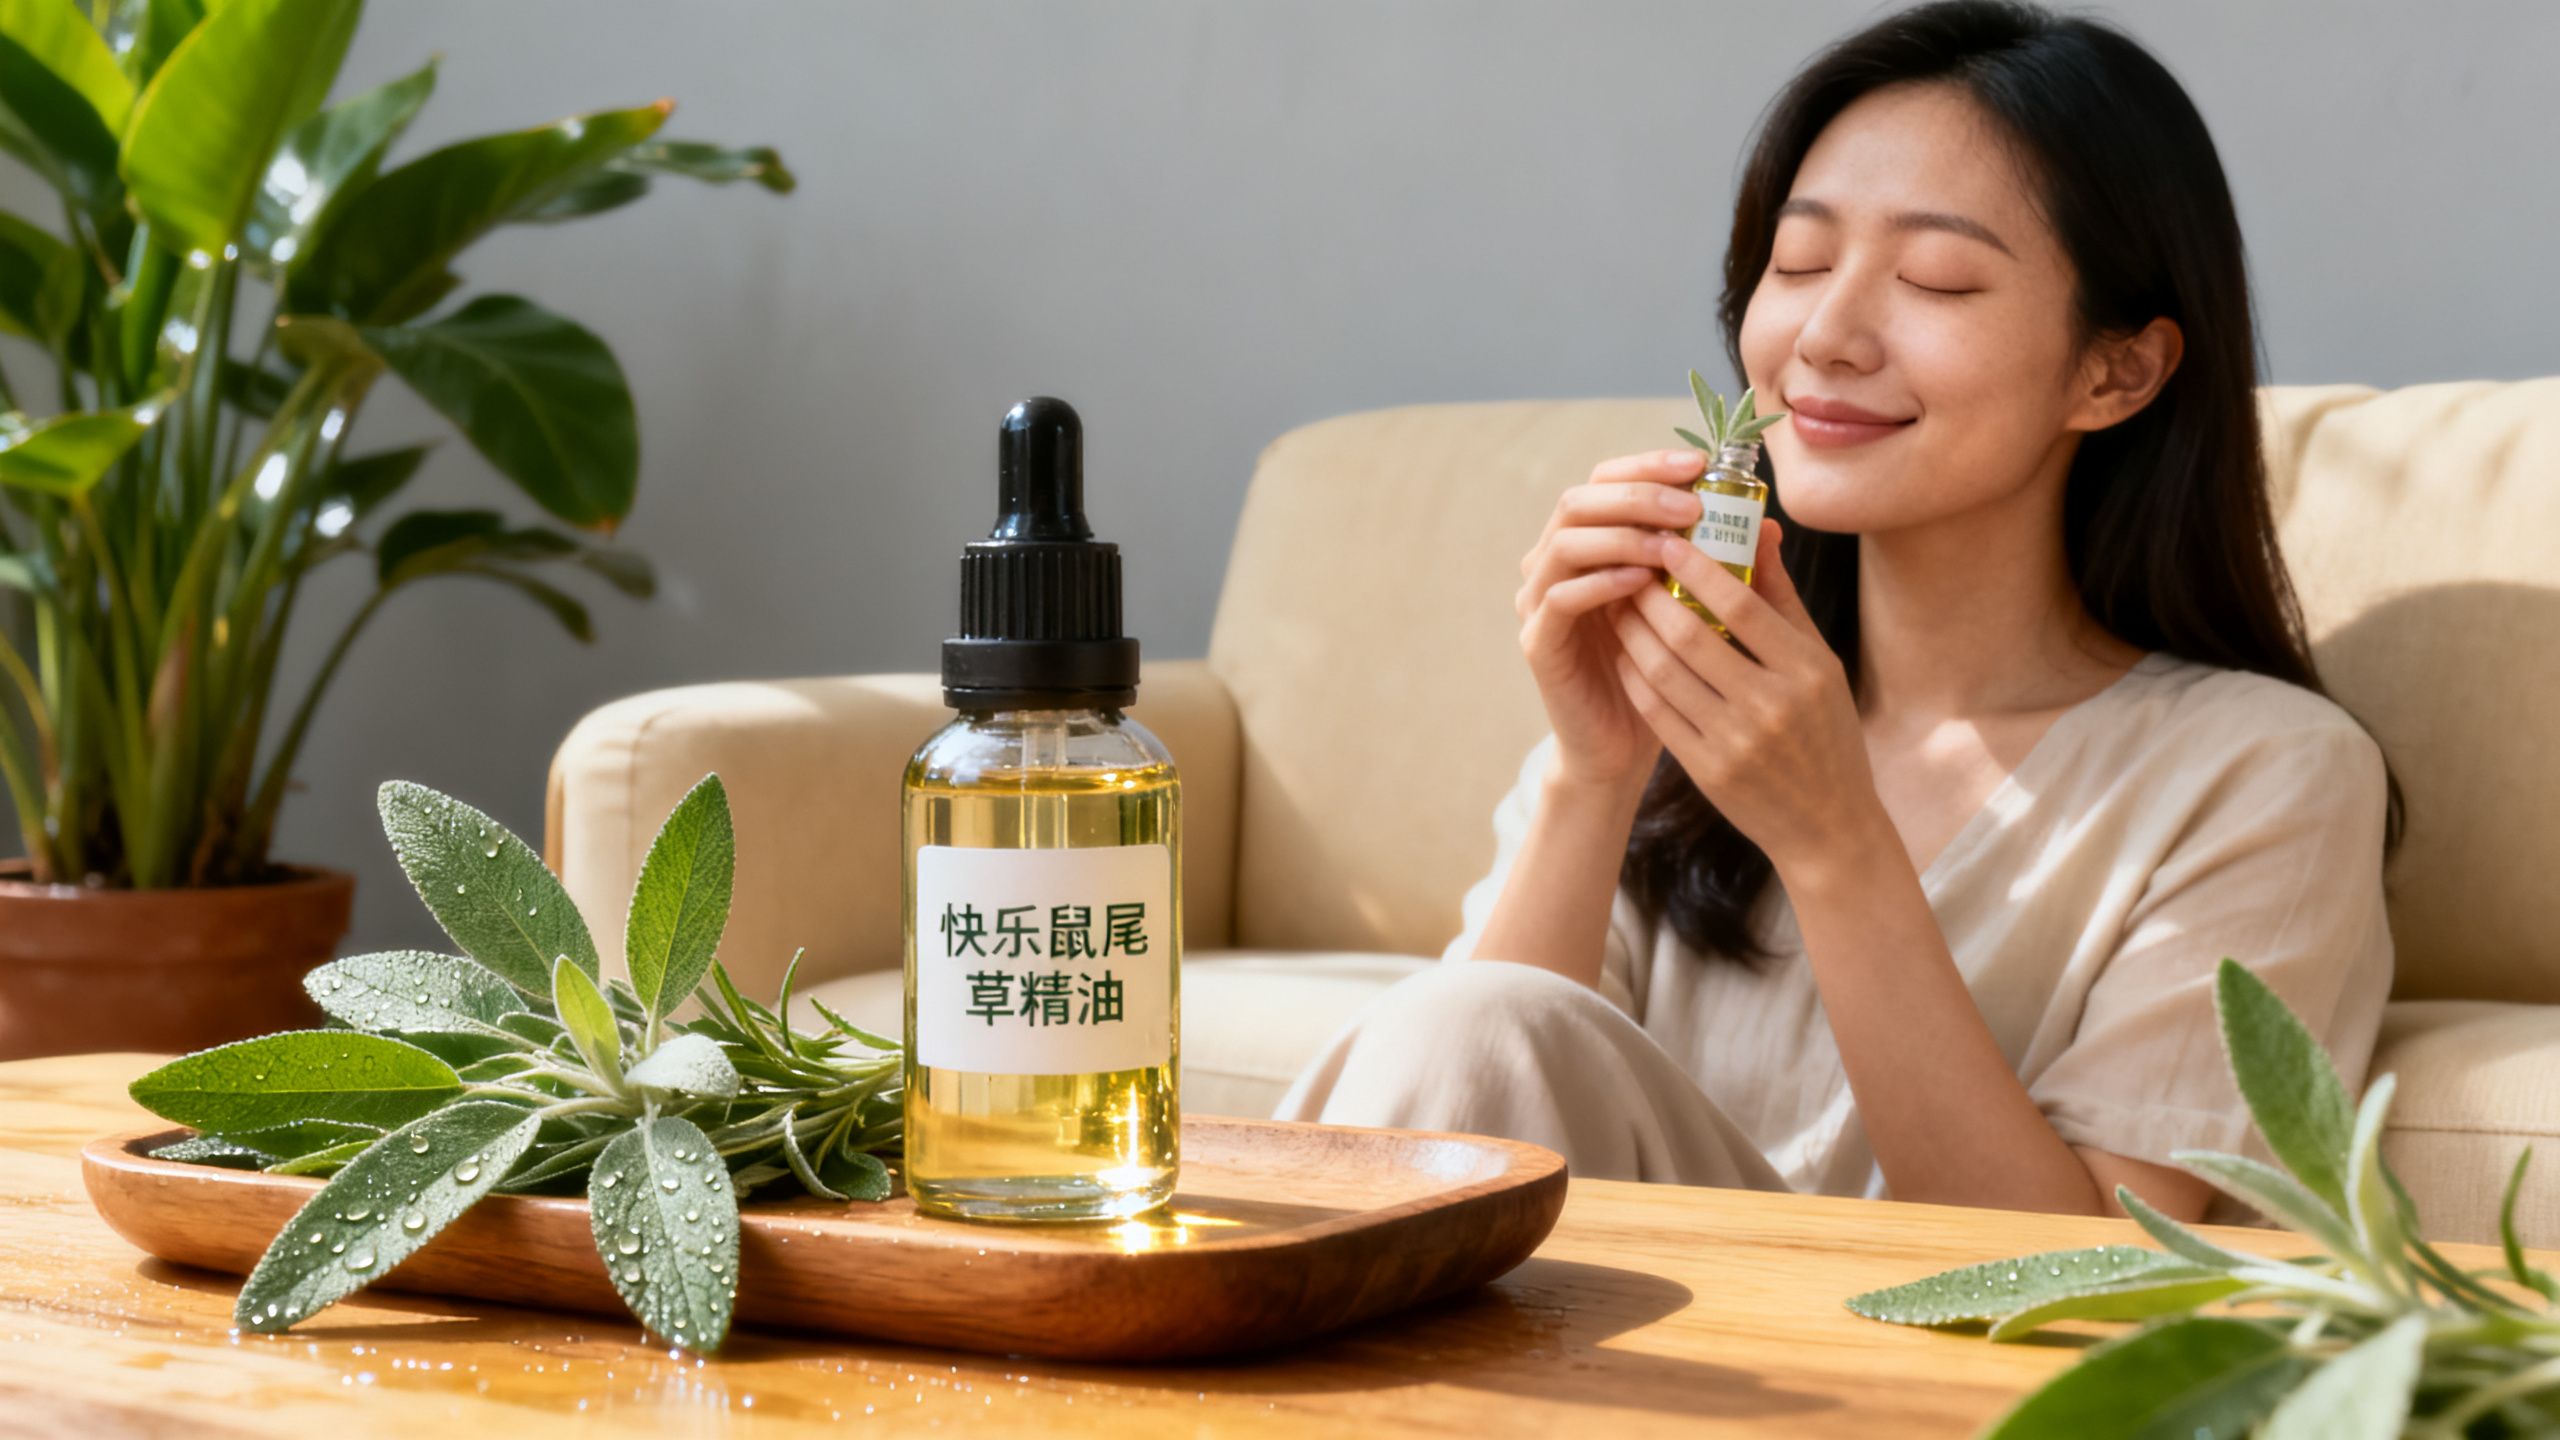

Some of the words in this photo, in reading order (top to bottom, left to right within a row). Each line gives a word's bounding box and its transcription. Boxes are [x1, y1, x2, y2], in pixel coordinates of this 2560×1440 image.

[940, 902, 1148, 960] 快乐鼠尾
[965, 969, 1124, 1027] 草精油
